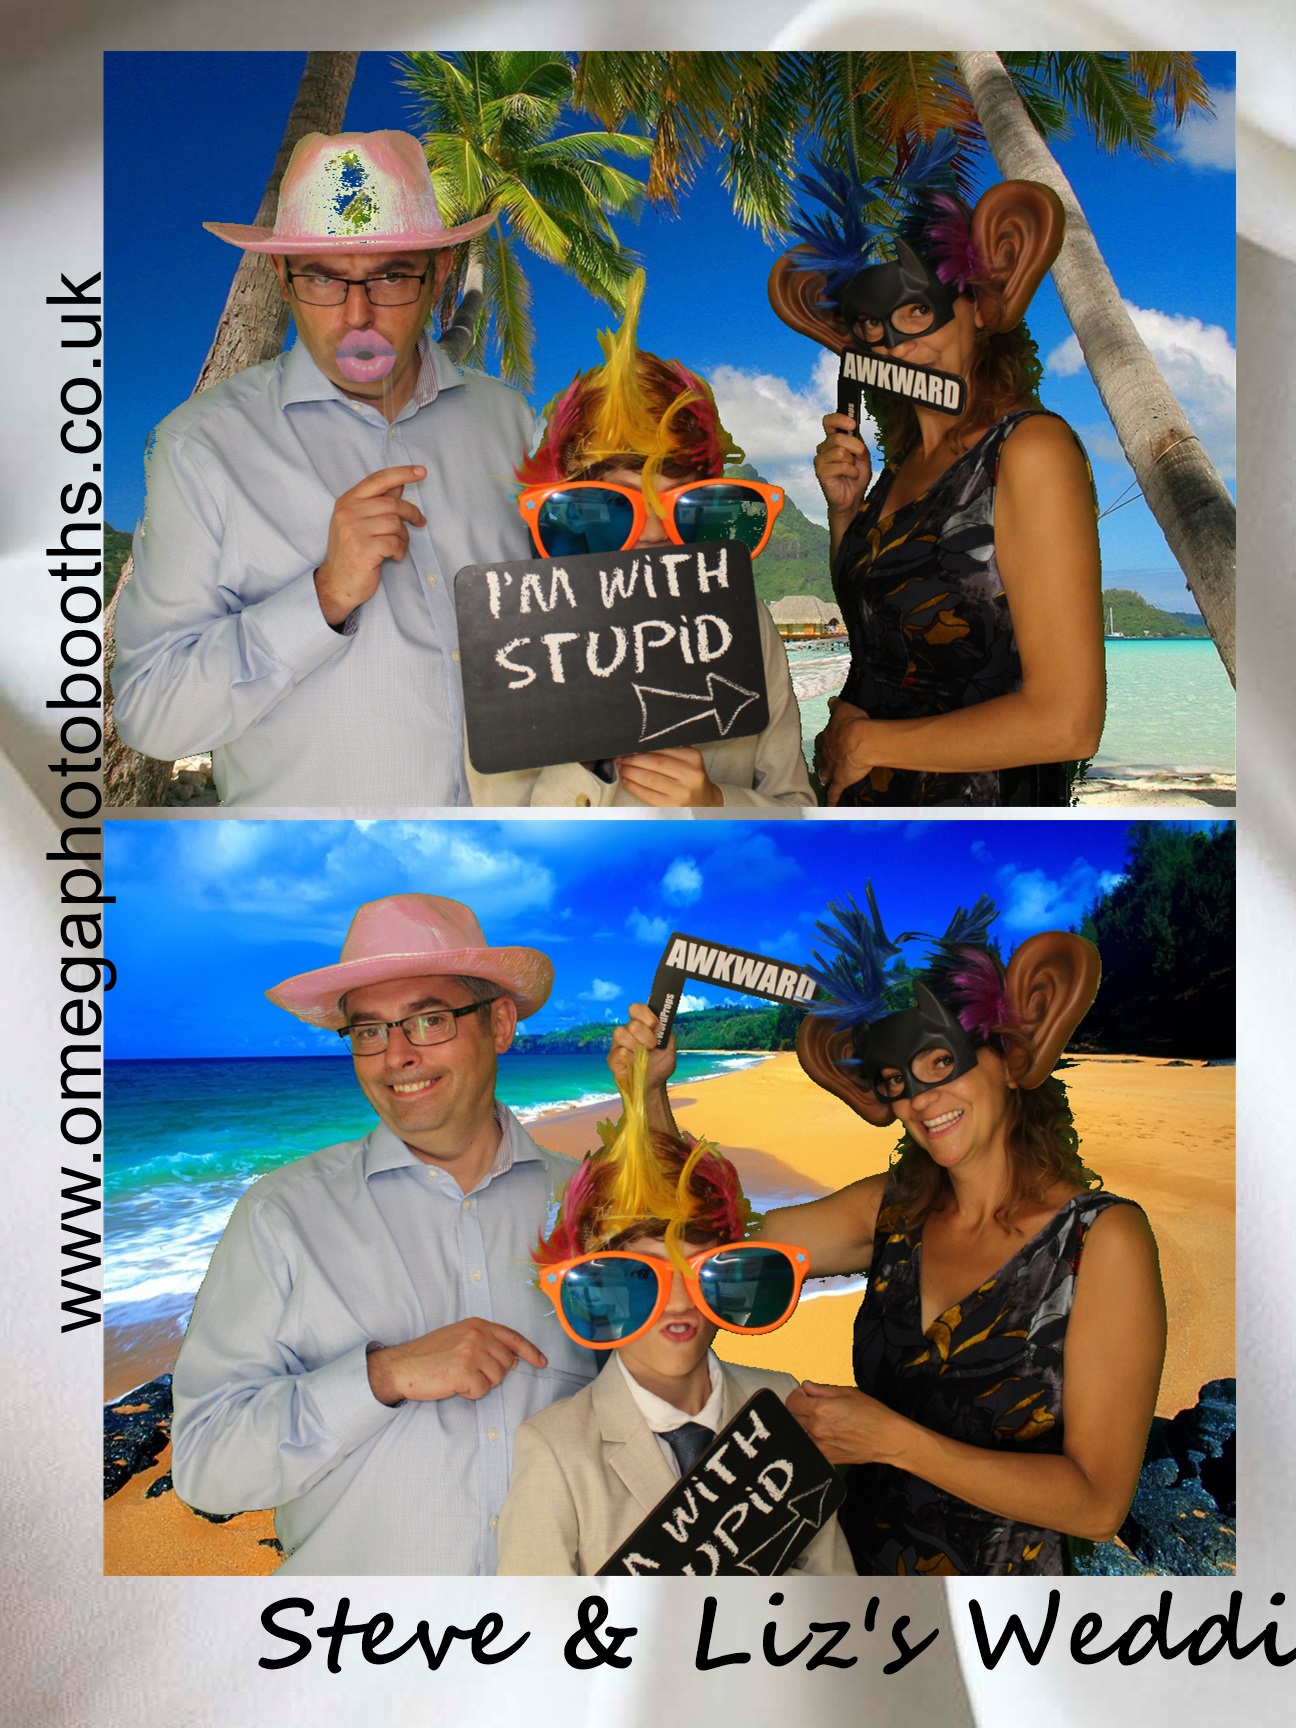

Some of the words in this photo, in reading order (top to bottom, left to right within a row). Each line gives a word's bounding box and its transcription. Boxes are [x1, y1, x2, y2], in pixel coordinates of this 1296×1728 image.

[843, 352, 960, 410] AWKWARD
[485, 567, 578, 619] I'M
[665, 938, 817, 1004] AWKWARD
